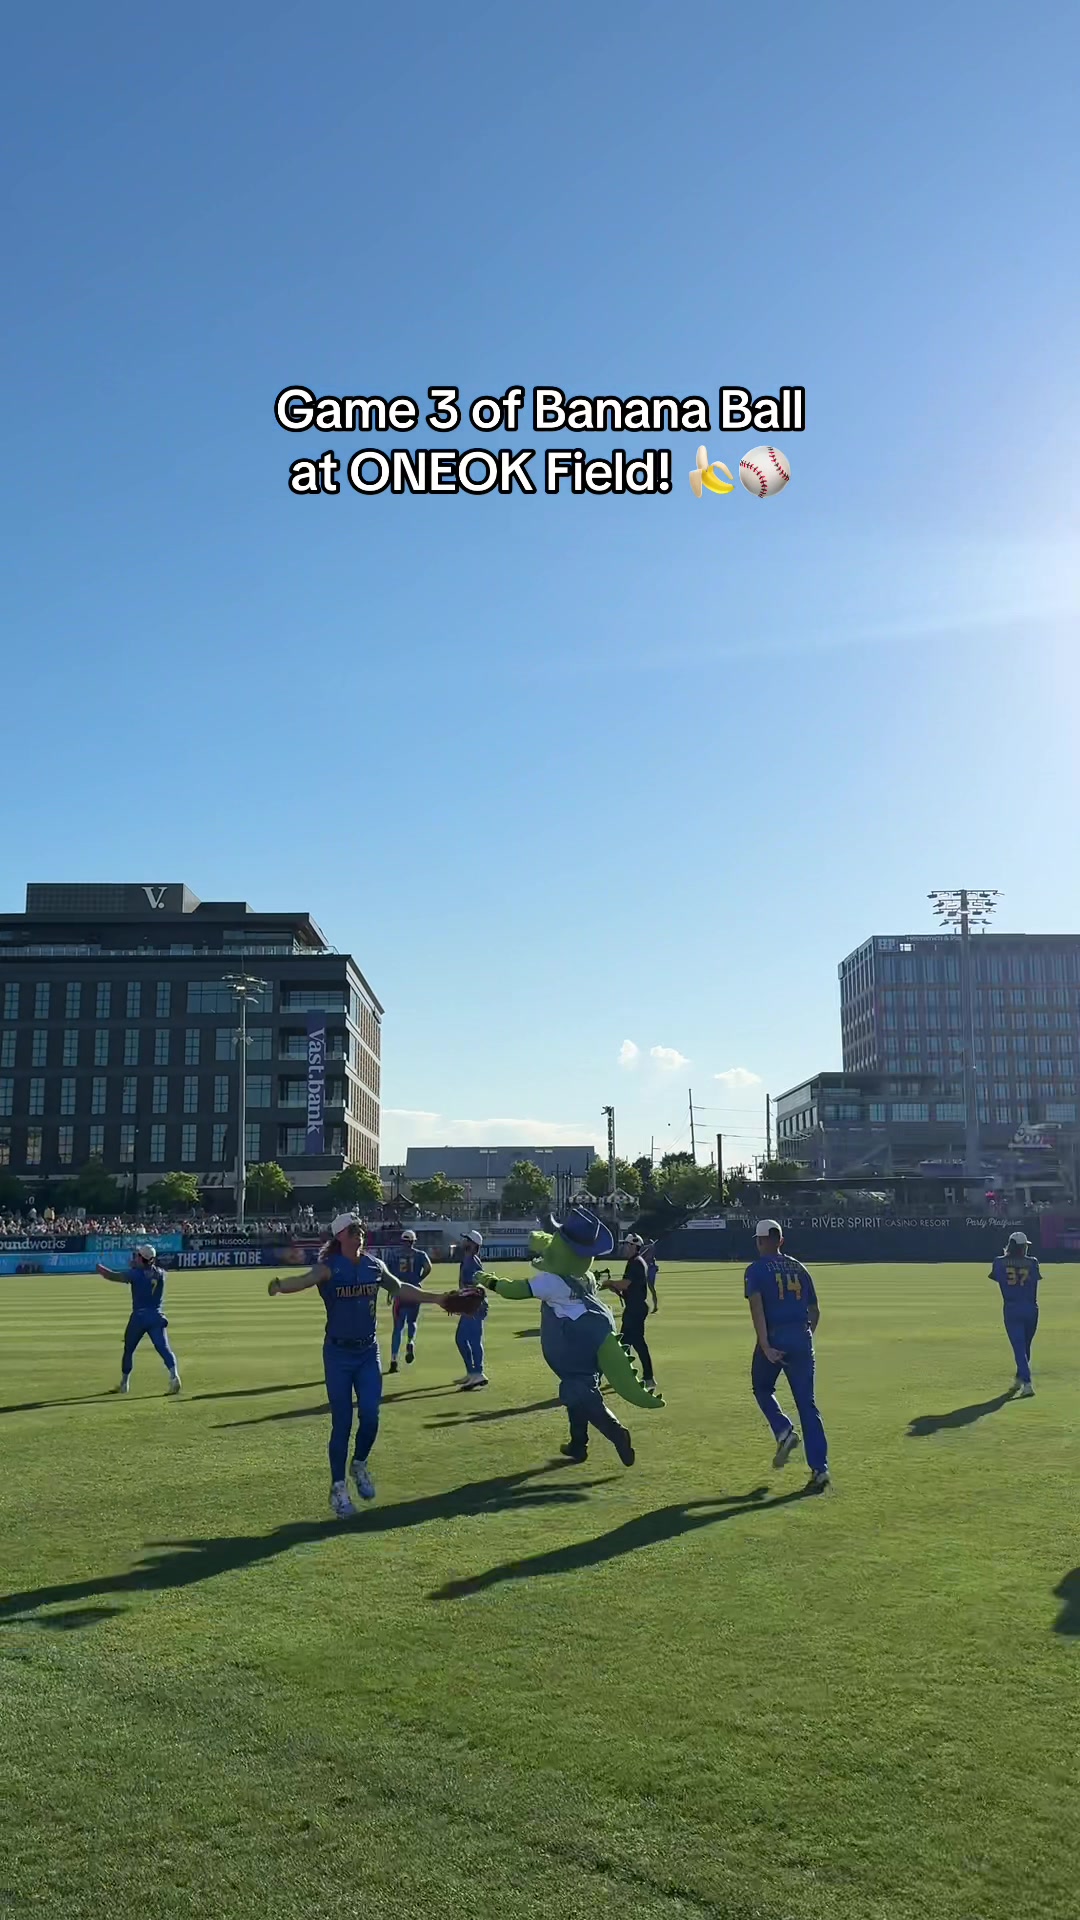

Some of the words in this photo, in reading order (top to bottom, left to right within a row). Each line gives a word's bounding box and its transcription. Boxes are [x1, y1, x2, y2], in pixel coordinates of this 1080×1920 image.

[307, 1027, 325, 1134] Vast.bank
[811, 1217, 844, 1229] RIVER
[848, 1217, 881, 1229] SPIRIT
[885, 1218, 918, 1228] CASINO
[920, 1218, 950, 1228] RESORT
[965, 1217, 987, 1228] Party
[177, 1252, 197, 1267] THE
[198, 1252, 231, 1266] PLACE
[233, 1251, 247, 1265] TO
[248, 1251, 262, 1265] BE
[775, 1272, 802, 1300] 14
